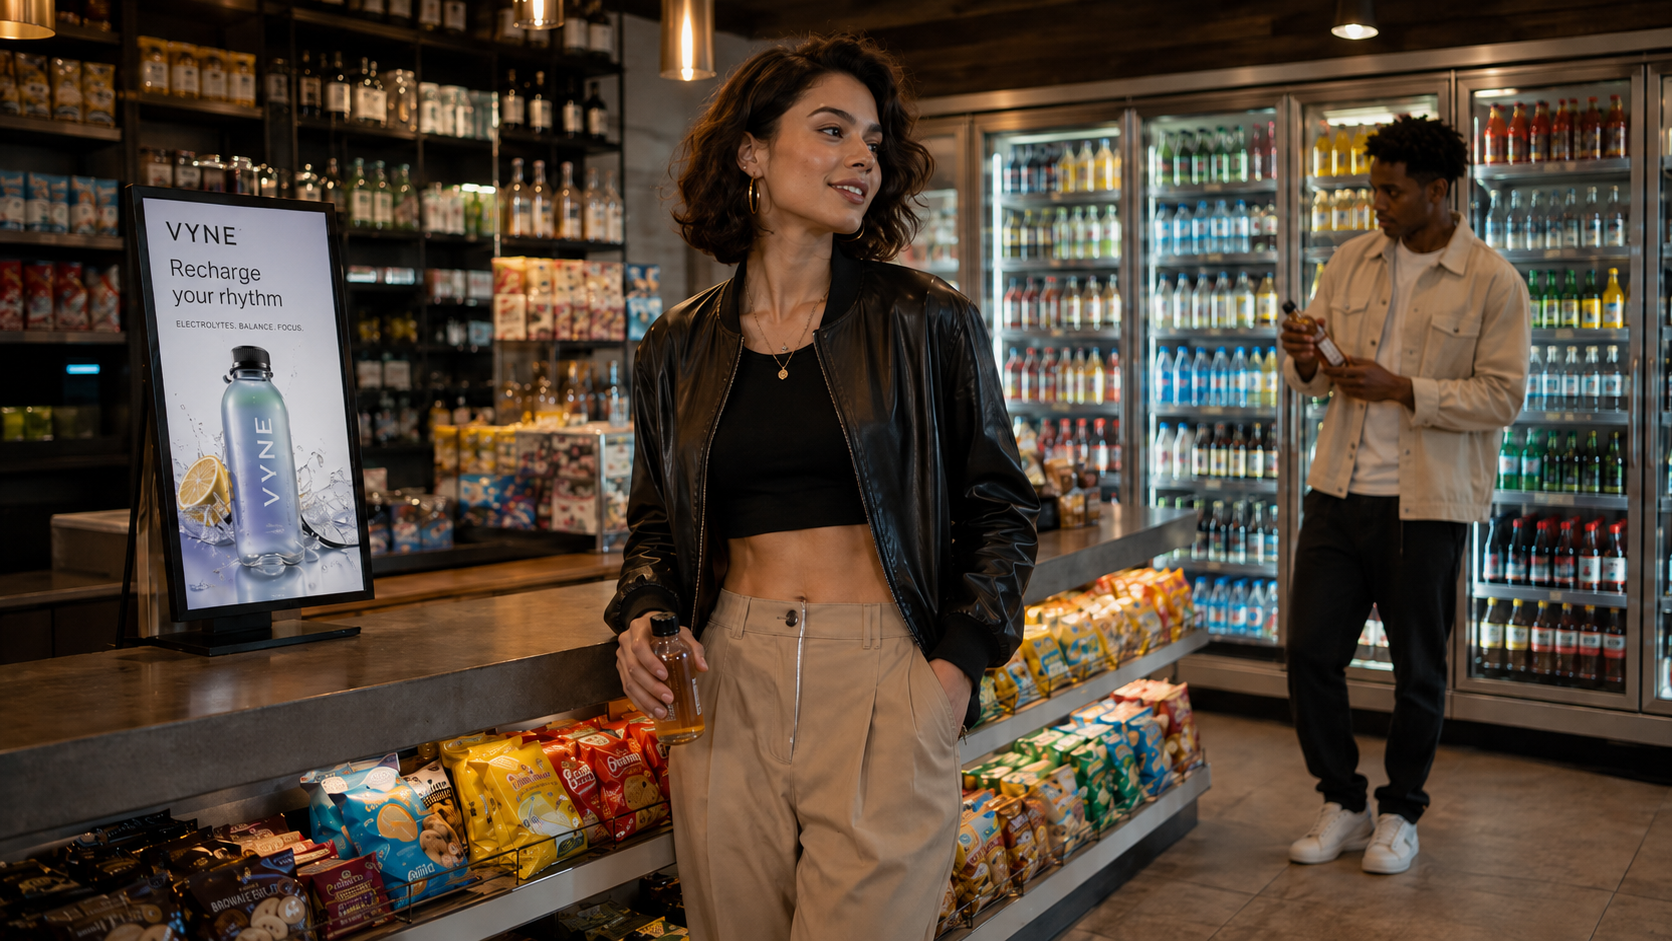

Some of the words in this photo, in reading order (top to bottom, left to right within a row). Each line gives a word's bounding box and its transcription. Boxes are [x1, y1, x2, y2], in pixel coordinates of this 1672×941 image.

[165, 221, 238, 246] VYNE
[170, 259, 261, 285] Recharge
[172, 289, 214, 307] your
[219, 288, 283, 309] rhythm
[176, 320, 237, 330] ELECTROLYTES.
[238, 322, 276, 331] BALANCE.
[277, 323, 304, 332] FOCUS.
[254, 417, 281, 507] VYNE
